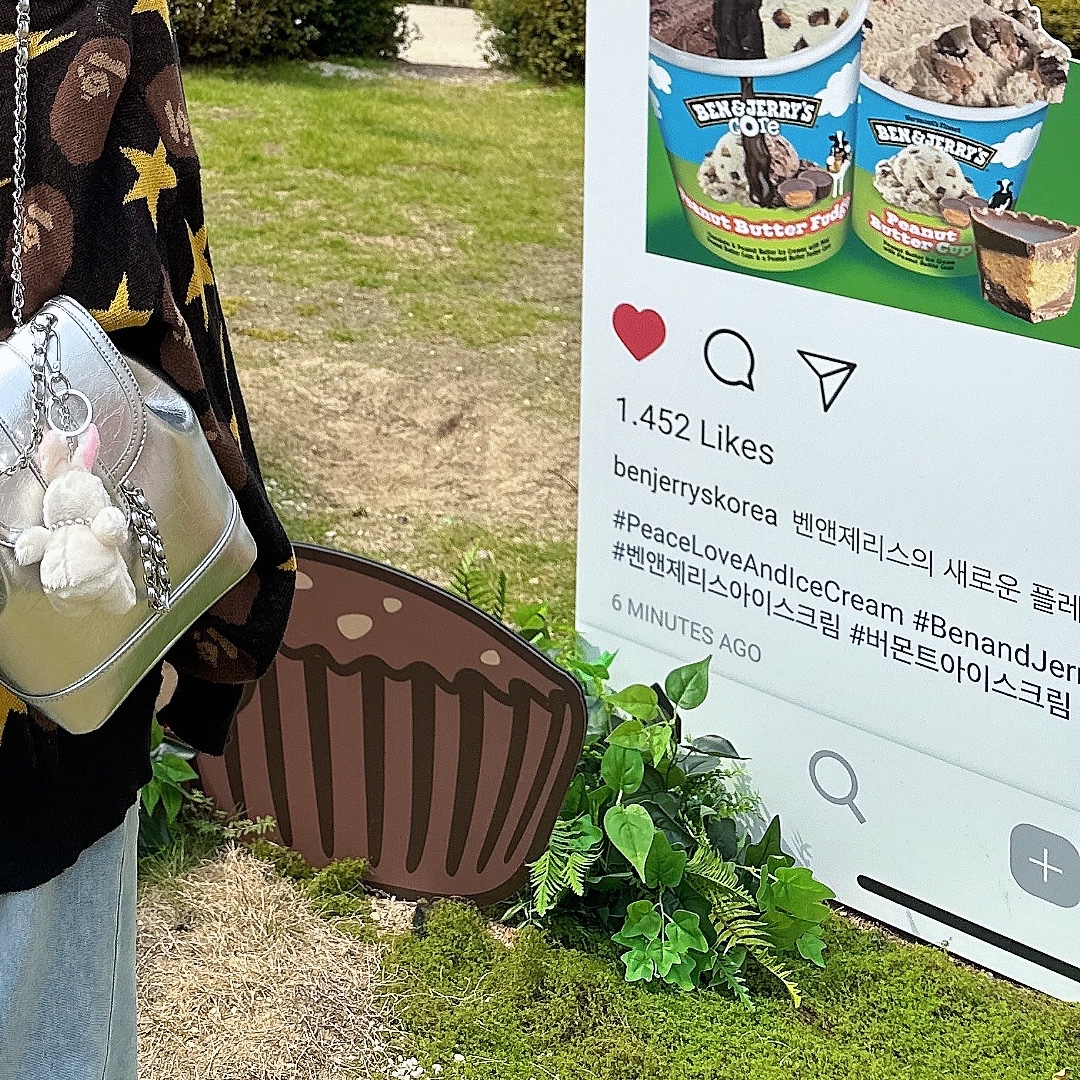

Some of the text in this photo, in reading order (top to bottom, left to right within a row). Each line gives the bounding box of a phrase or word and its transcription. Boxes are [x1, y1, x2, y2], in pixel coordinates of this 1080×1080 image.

[692, 98, 816, 122] BEN&JERRY'S
[875, 124, 990, 165] BEN&JERRY'S
[733, 219, 808, 237] Butter
[869, 213, 934, 251] Butter
[886, 211, 958, 242] Peanut
[616, 397, 774, 465] 1.452 Likes
[614, 454, 778, 527] benjerryskorea
[793, 509, 933, 577] 벤앤제리스의
[943, 558, 1022, 604] 새로운
[612, 509, 904, 626] #PeaceLoveAndIceCream
[611, 593, 762, 663] 6 MINUTES AGO
[611, 540, 1070, 721] #벤앤제리스아이스크림 #버몬트아이스크림
